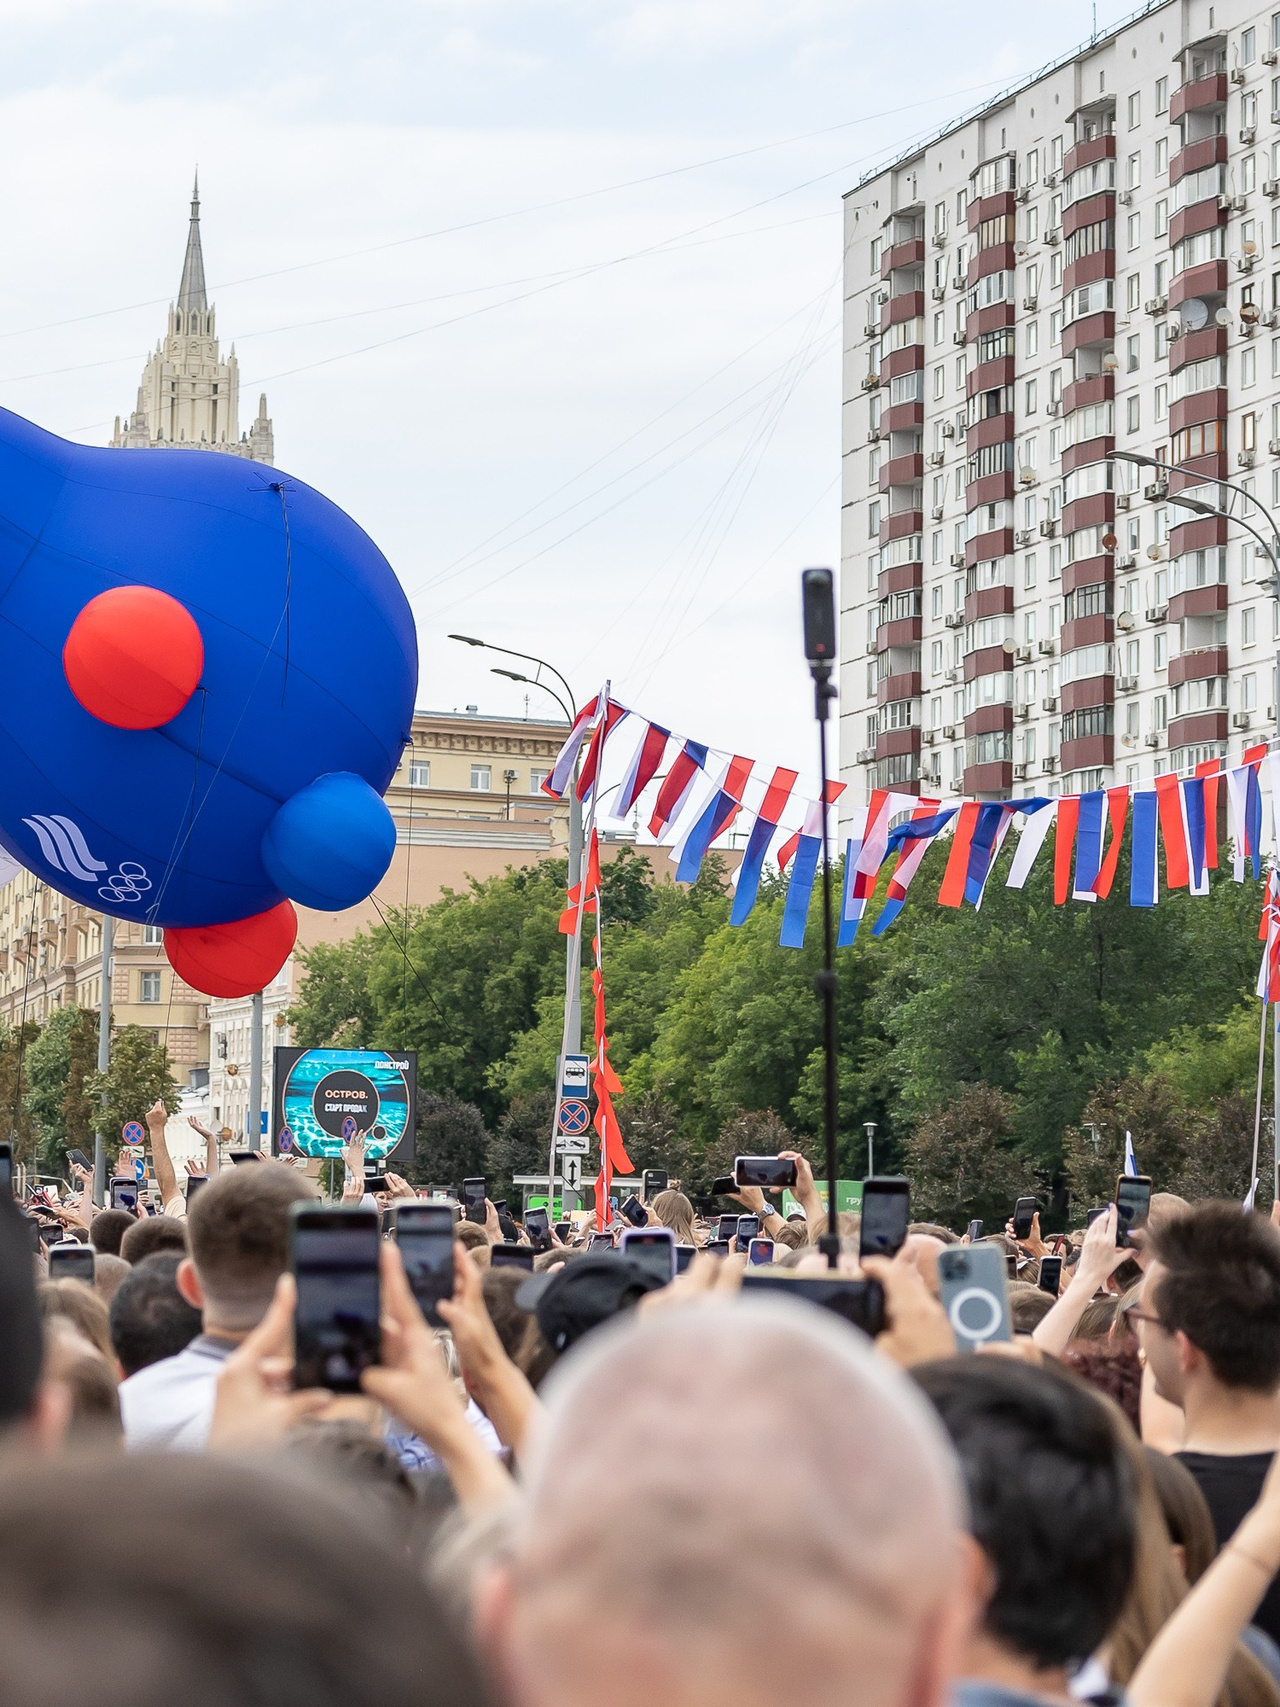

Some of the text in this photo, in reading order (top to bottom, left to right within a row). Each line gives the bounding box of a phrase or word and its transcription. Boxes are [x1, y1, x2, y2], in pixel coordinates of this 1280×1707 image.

[374, 1060, 409, 1070] ДОНСТРОЙ
[325, 1089, 368, 1099] ОСТРОВ.
[324, 1103, 343, 1112] СТАРТ
